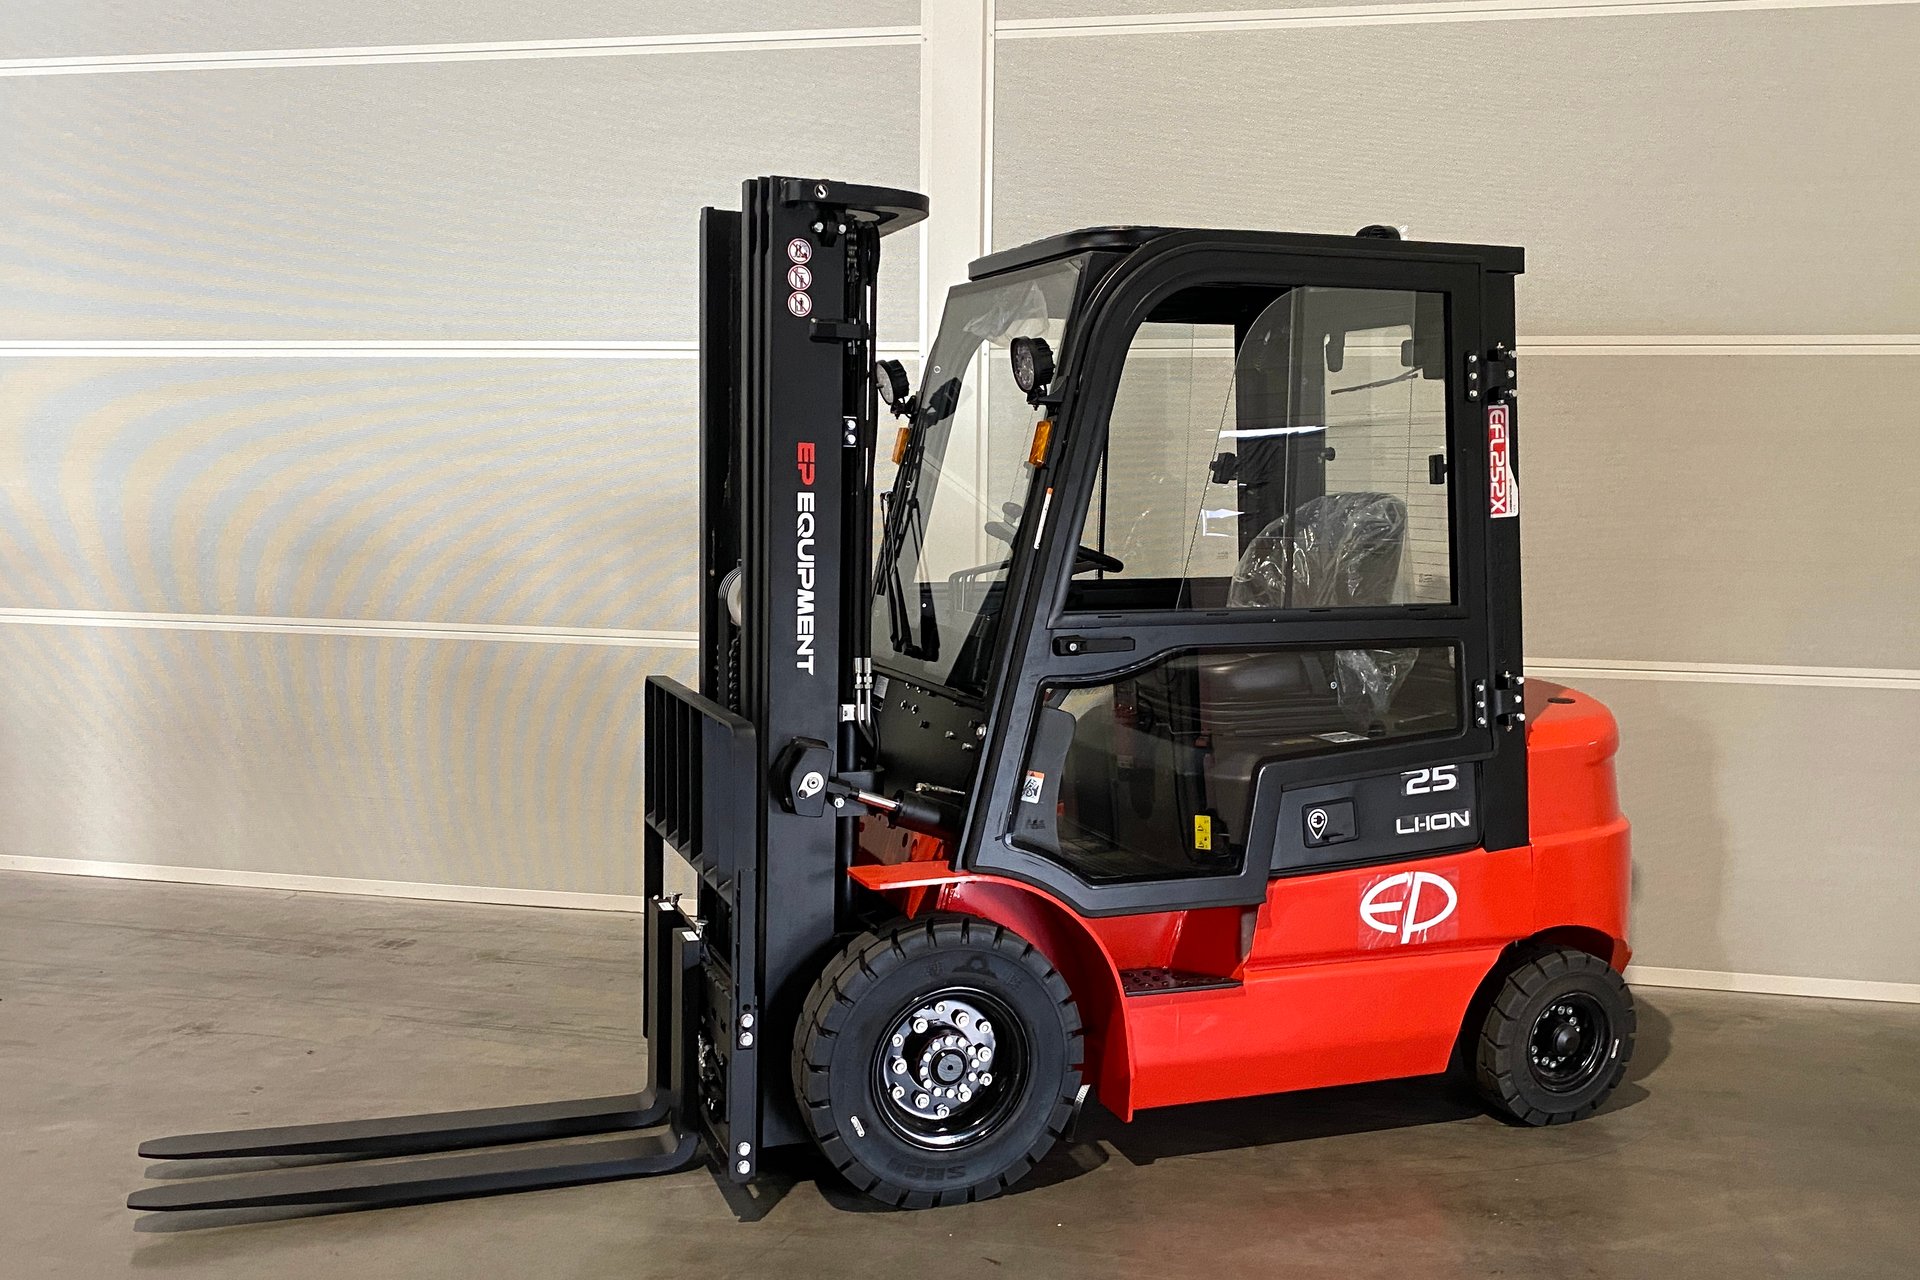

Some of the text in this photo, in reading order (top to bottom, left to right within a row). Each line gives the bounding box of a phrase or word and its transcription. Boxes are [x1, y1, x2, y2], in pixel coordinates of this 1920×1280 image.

[1490, 410, 1506, 513] EFL252X
[796, 441, 816, 676] EP EQUIPMENT
[1403, 764, 1457, 795] 25
